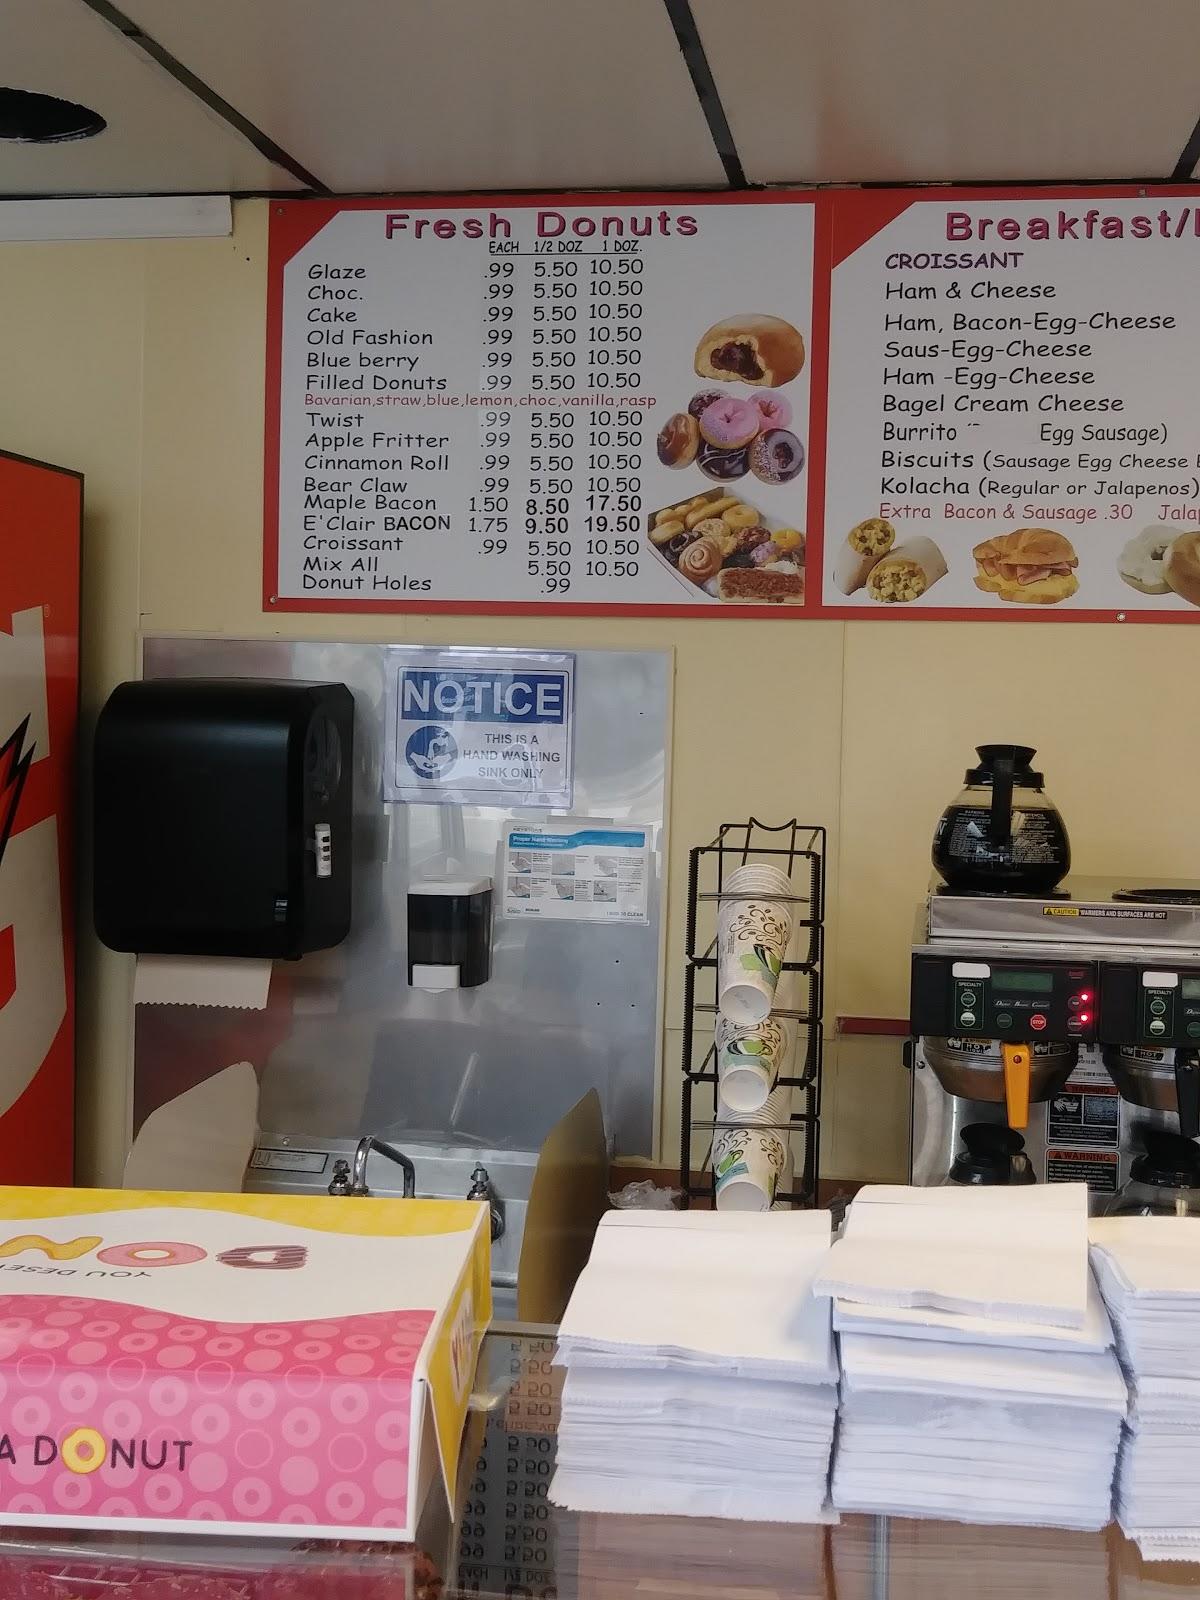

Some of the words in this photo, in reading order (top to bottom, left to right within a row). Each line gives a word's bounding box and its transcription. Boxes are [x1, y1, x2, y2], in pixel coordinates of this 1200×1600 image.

[385, 213, 511, 240] Fresh
[537, 211, 698, 237] Donuts
[489, 241, 519, 253] EACH
[534, 241, 553, 252] 1/2
[558, 241, 583, 252] DOZ
[602, 241, 607, 252] 1
[614, 240, 643, 252] DOZ.
[308, 264, 366, 279] Glaze
[484, 263, 514, 278] .99
[534, 262, 577, 277] 5.50
[590, 259, 643, 275] 10.50
[885, 252, 1024, 271] CROISSANT
[308, 285, 363, 300] Choc.
[484, 284, 513, 299] .99
[534, 283, 577, 298] 5.50
[590, 280, 643, 296] 10.50
[886, 282, 936, 300] Ham
[946, 282, 961, 299] &
[971, 281, 1056, 298] Cheese
[307, 307, 357, 322] Cake
[483, 307, 513, 322] .99
[532, 306, 576, 321] 5.50
[589, 304, 642, 319] 10.50
[885, 314, 943, 333] Ham,
[953, 312, 1176, 335] Bacon-Egg-Cheese
[307, 329, 344, 345] Old
[353, 329, 432, 345] Fashion
[483, 329, 512, 345] .99
[533, 329, 576, 344] 5.50
[588, 327, 642, 342] 10.50
[884, 339, 1092, 362] Saus-Egg-Cheese
[307, 352, 351, 367] Blue
[360, 352, 419, 372] berry
[482, 352, 512, 367] .99
[532, 352, 575, 367] 5.50
[588, 350, 641, 365] 10.50
[307, 374, 364, 390] Filled
[373, 375, 447, 390] Donuts
[482, 375, 511, 390] .99
[532, 375, 575, 390] 5.50
[588, 373, 640, 388] 10.50
[884, 368, 934, 385] Ham
[944, 366, 1095, 390] -Egg-Cheese
[883, 394, 944, 417] Bagel
[954, 395, 1028, 412] Cream
[1038, 394, 1124, 411] Cheese
[305, 413, 364, 427] Twist
[481, 412, 511, 427] .99
[531, 413, 574, 428] 5.50
[590, 411, 642, 426] 10.50
[305, 432, 364, 452] Apple
[373, 432, 449, 448] Fritter
[481, 432, 510, 447] .99
[531, 433, 574, 448] 5.50
[589, 431, 642, 447] 10.50
[884, 422, 957, 441] Burrito
[1041, 423, 1074, 446] Egg
[1082, 423, 1167, 446] Sausage)
[305, 455, 402, 470] Cinnamon
[411, 455, 448, 470] Roll
[480, 455, 509, 470] .99
[530, 456, 573, 471] 5.50
[589, 454, 641, 469] 10.50
[882, 450, 974, 468] Biscuits
[983, 450, 1070, 472] (Sausage
[1078, 454, 1112, 472] Egg
[1119, 454, 1189, 468] Cheese
[304, 477, 352, 492] Bear
[360, 477, 407, 493] Claw
[480, 478, 509, 493] .99
[530, 479, 573, 494] 5.50
[588, 477, 641, 493] 10.50
[881, 476, 969, 494] Kolacha
[979, 477, 1059, 498] (Regular
[1067, 485, 1087, 495] or
[1094, 477, 1199, 499] Jalapenos)
[304, 494, 366, 514] Maple
[375, 494, 436, 510] Bacon
[469, 497, 508, 512] 1.50
[526, 498, 569, 515] 8.50
[586, 495, 641, 512] 17.50
[880, 503, 931, 518] Extra
[945, 503, 996, 519] Bacon
[1003, 504, 1015, 519] &
[1022, 504, 1097, 524] Sausage
[1104, 504, 1132, 519] .30
[304, 515, 375, 531] E'Clair
[384, 515, 450, 531] BACON
[469, 517, 508, 532] 1.75
[525, 517, 568, 534] 9.50
[584, 516, 640, 532] 19.50
[304, 535, 403, 551] Croissant
[478, 539, 507, 554] .99
[528, 541, 571, 556] 5.50
[587, 540, 639, 555] 10.50
[303, 556, 342, 571] Mix
[351, 556, 378, 572] All
[528, 561, 571, 576] 5.50
[586, 561, 639, 576] 10.50
[303, 574, 365, 589] Donut
[373, 575, 431, 590] Holes
[541, 578, 570, 593] .99
[404, 680, 561, 716] NOTICE
[485, 733, 512, 744] THIS
[516, 734, 526, 744] IS
[530, 735, 539, 745] A
[463, 750, 497, 761] HAND
[502, 751, 560, 762] WASHING
[478, 767, 507, 777] SINK
[511, 768, 544, 778] ONLY
[86, 1270, 152, 1278] YOU
[34, 1427, 193, 1474] DONUT
